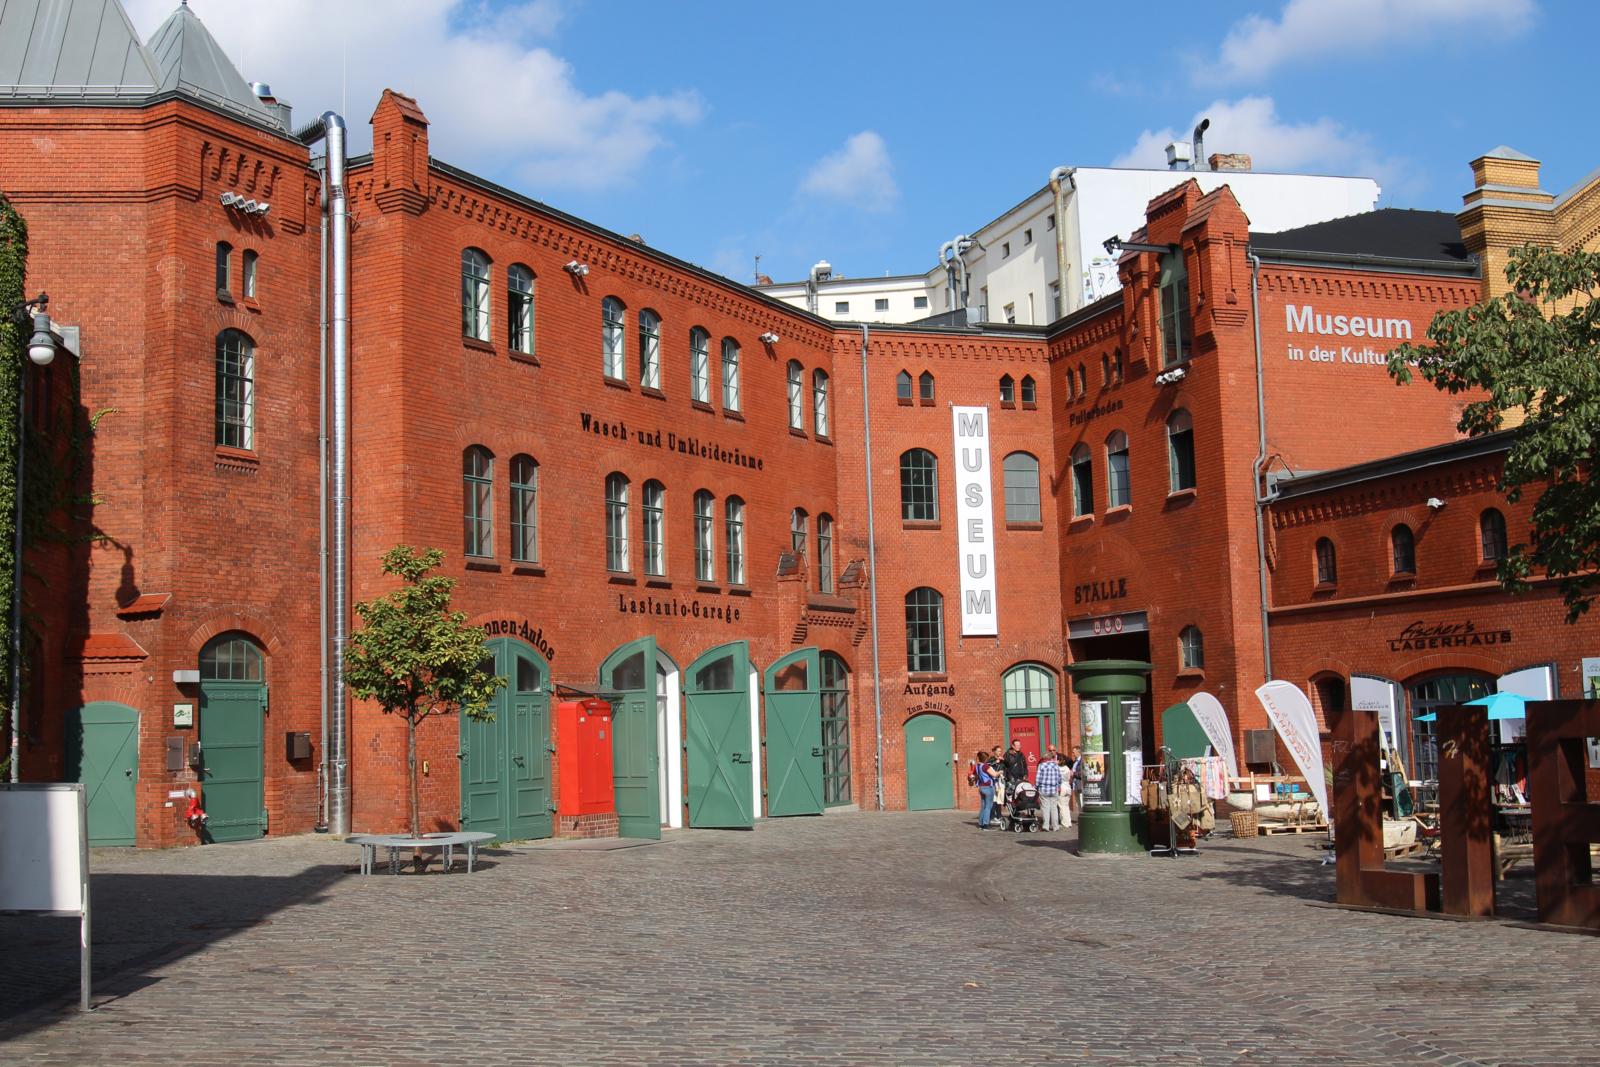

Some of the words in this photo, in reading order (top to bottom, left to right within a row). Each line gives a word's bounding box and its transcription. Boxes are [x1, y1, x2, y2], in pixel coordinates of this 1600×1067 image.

[1285, 304, 1412, 339] Museum
[1287, 344, 1304, 361] in
[1309, 345, 1336, 362] der
[668, 432, 764, 471] Umkleideräume
[957, 412, 992, 615] MUSEUM
[618, 594, 741, 624] Lastauto-Garage
[1390, 630, 1512, 652] LAGERHAUS
[902, 684, 956, 697] Aufgang
[906, 704, 924, 715] Zum
[924, 701, 943, 711] Stall
